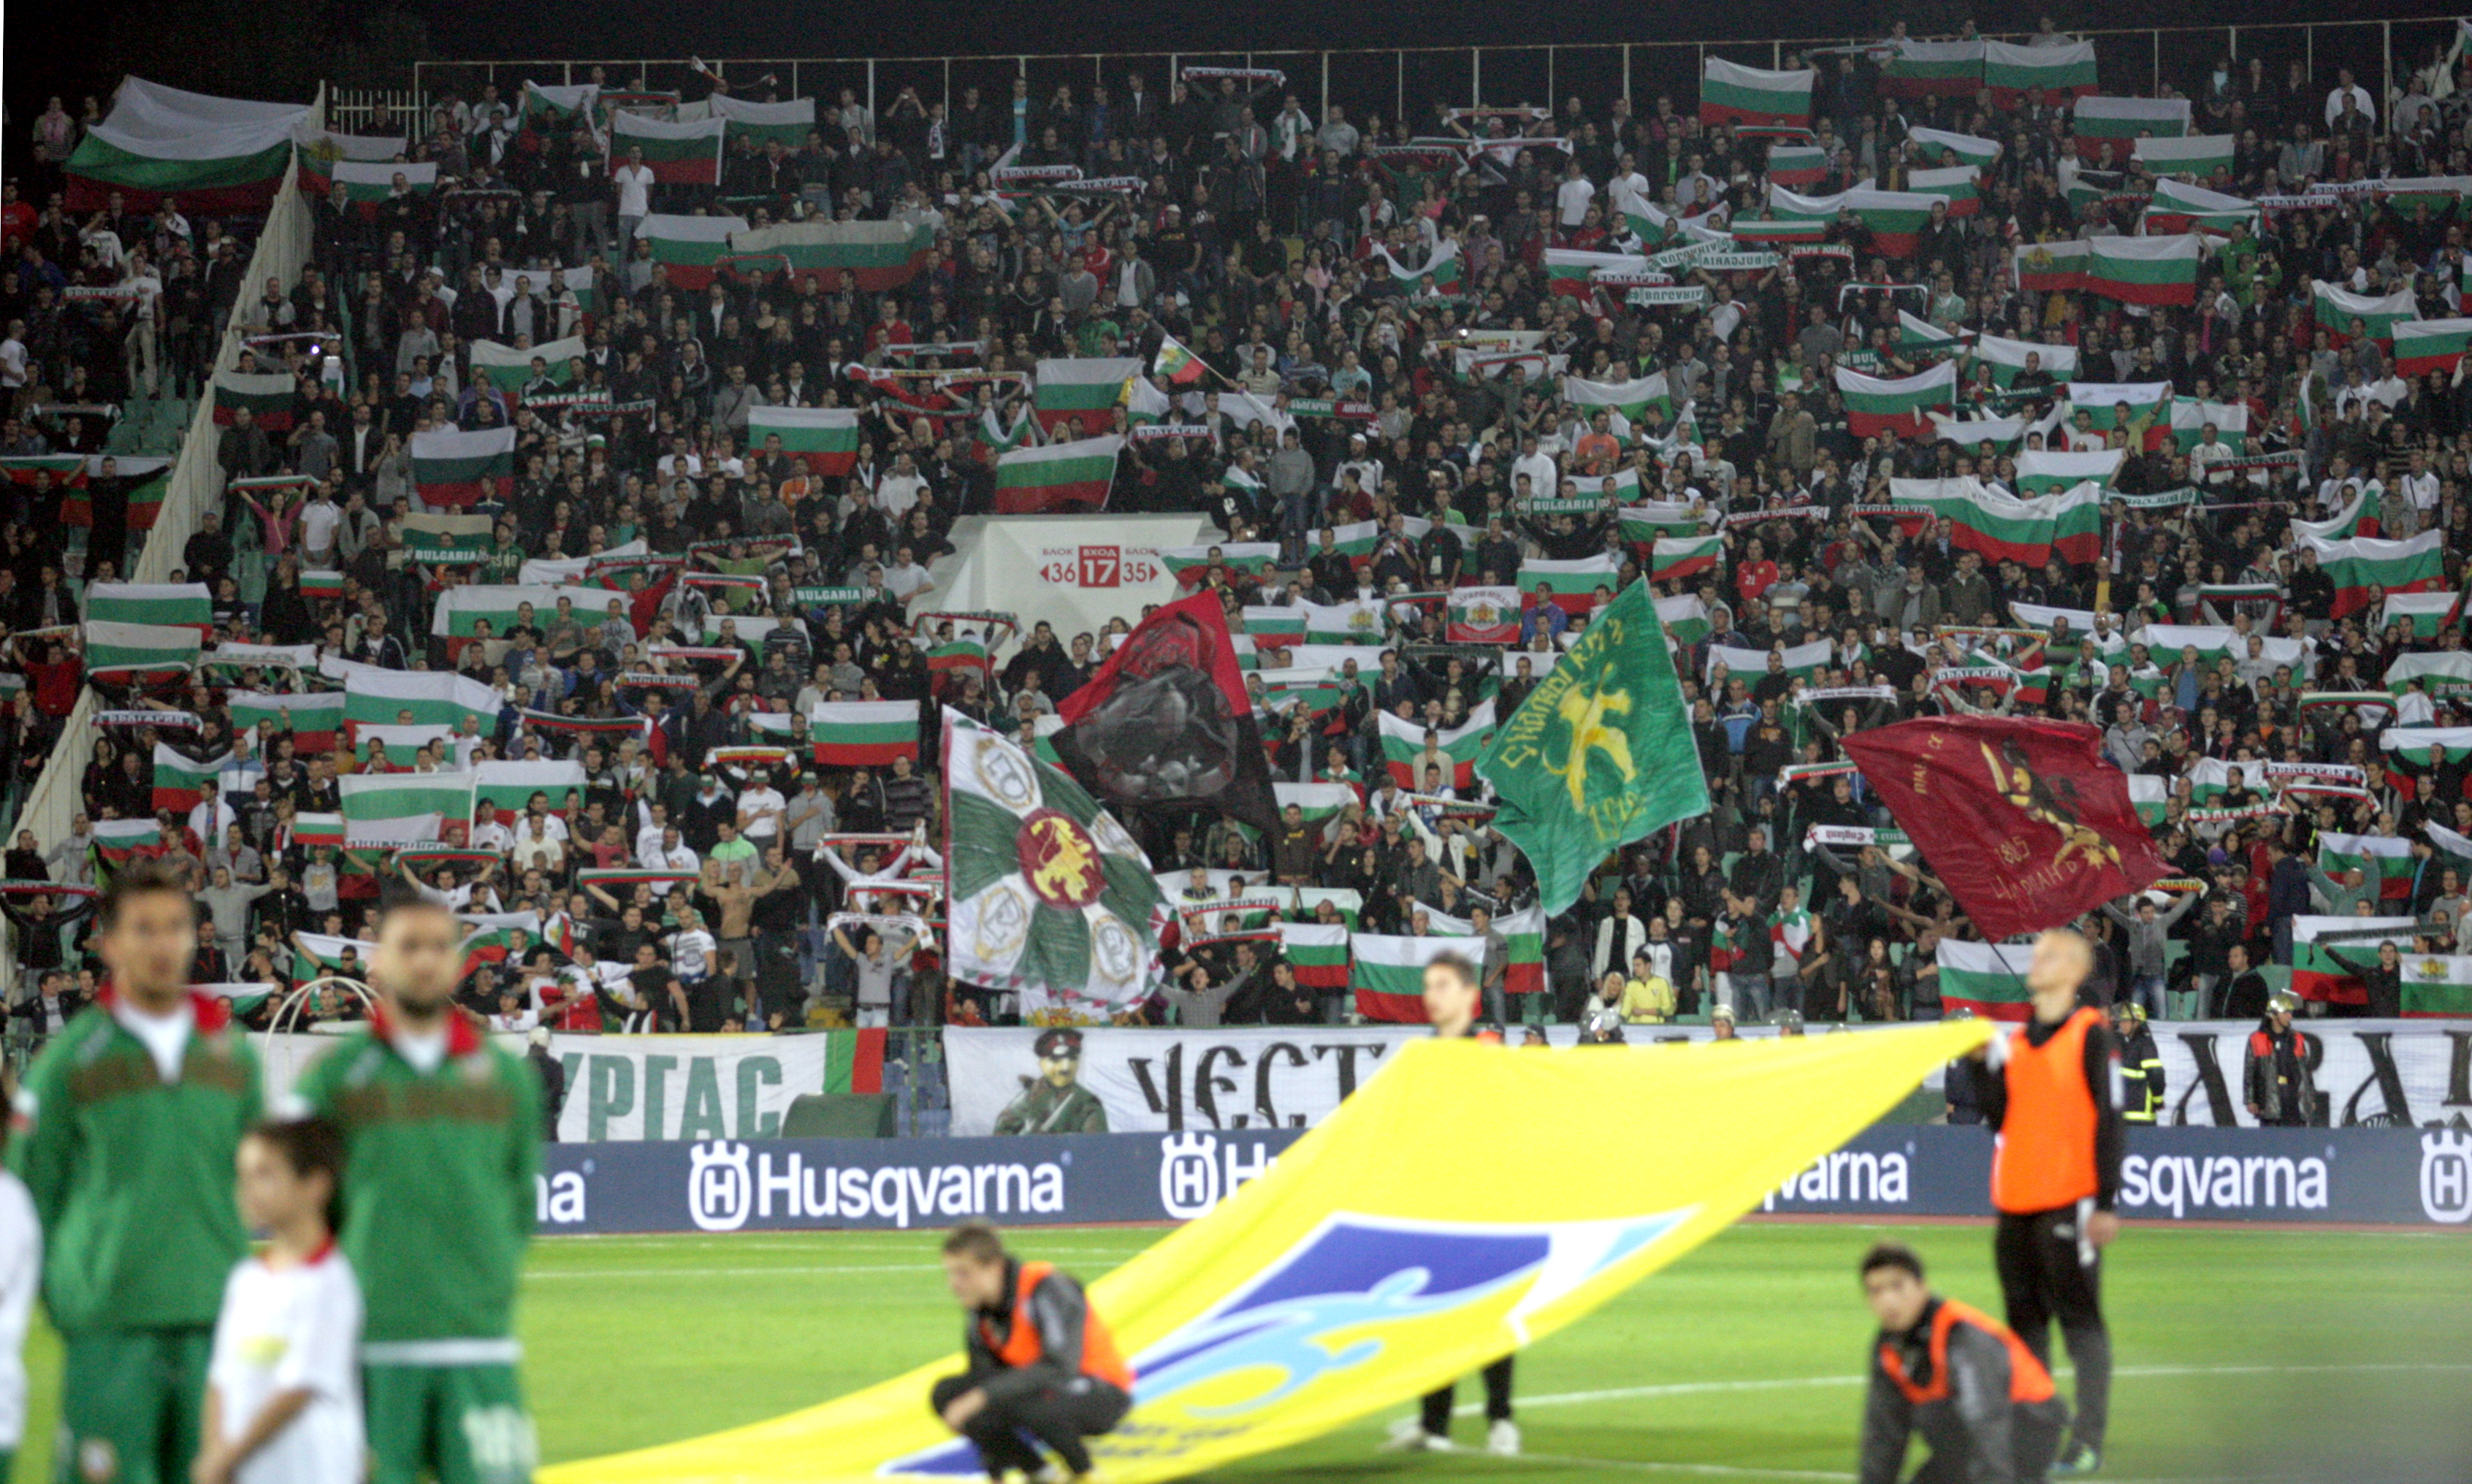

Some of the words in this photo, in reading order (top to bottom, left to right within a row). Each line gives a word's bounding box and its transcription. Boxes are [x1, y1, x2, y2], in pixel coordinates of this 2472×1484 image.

[1533, 500, 1595, 511] BULGARIA
[414, 550, 477, 561] BULGARIA
[1083, 548, 1117, 557] ВХОД
[1051, 562, 1075, 583] 36
[1083, 559, 1117, 584] 17
[1124, 562, 1148, 583] 35
[796, 589, 861, 600] BULGARIA
[1938, 668, 2008, 680] БЪЛГАРИЯ
[109, 714, 184, 724] БЪЛГАРИЯ
[2267, 766, 2347, 778] БЪЛГАРИЯ
[1826, 830, 1866, 843] England
[1764, 1152, 1909, 1212] varna
[2121, 1155, 2329, 1218] sqvarna
[758, 1152, 1064, 1228] Husqvarna
